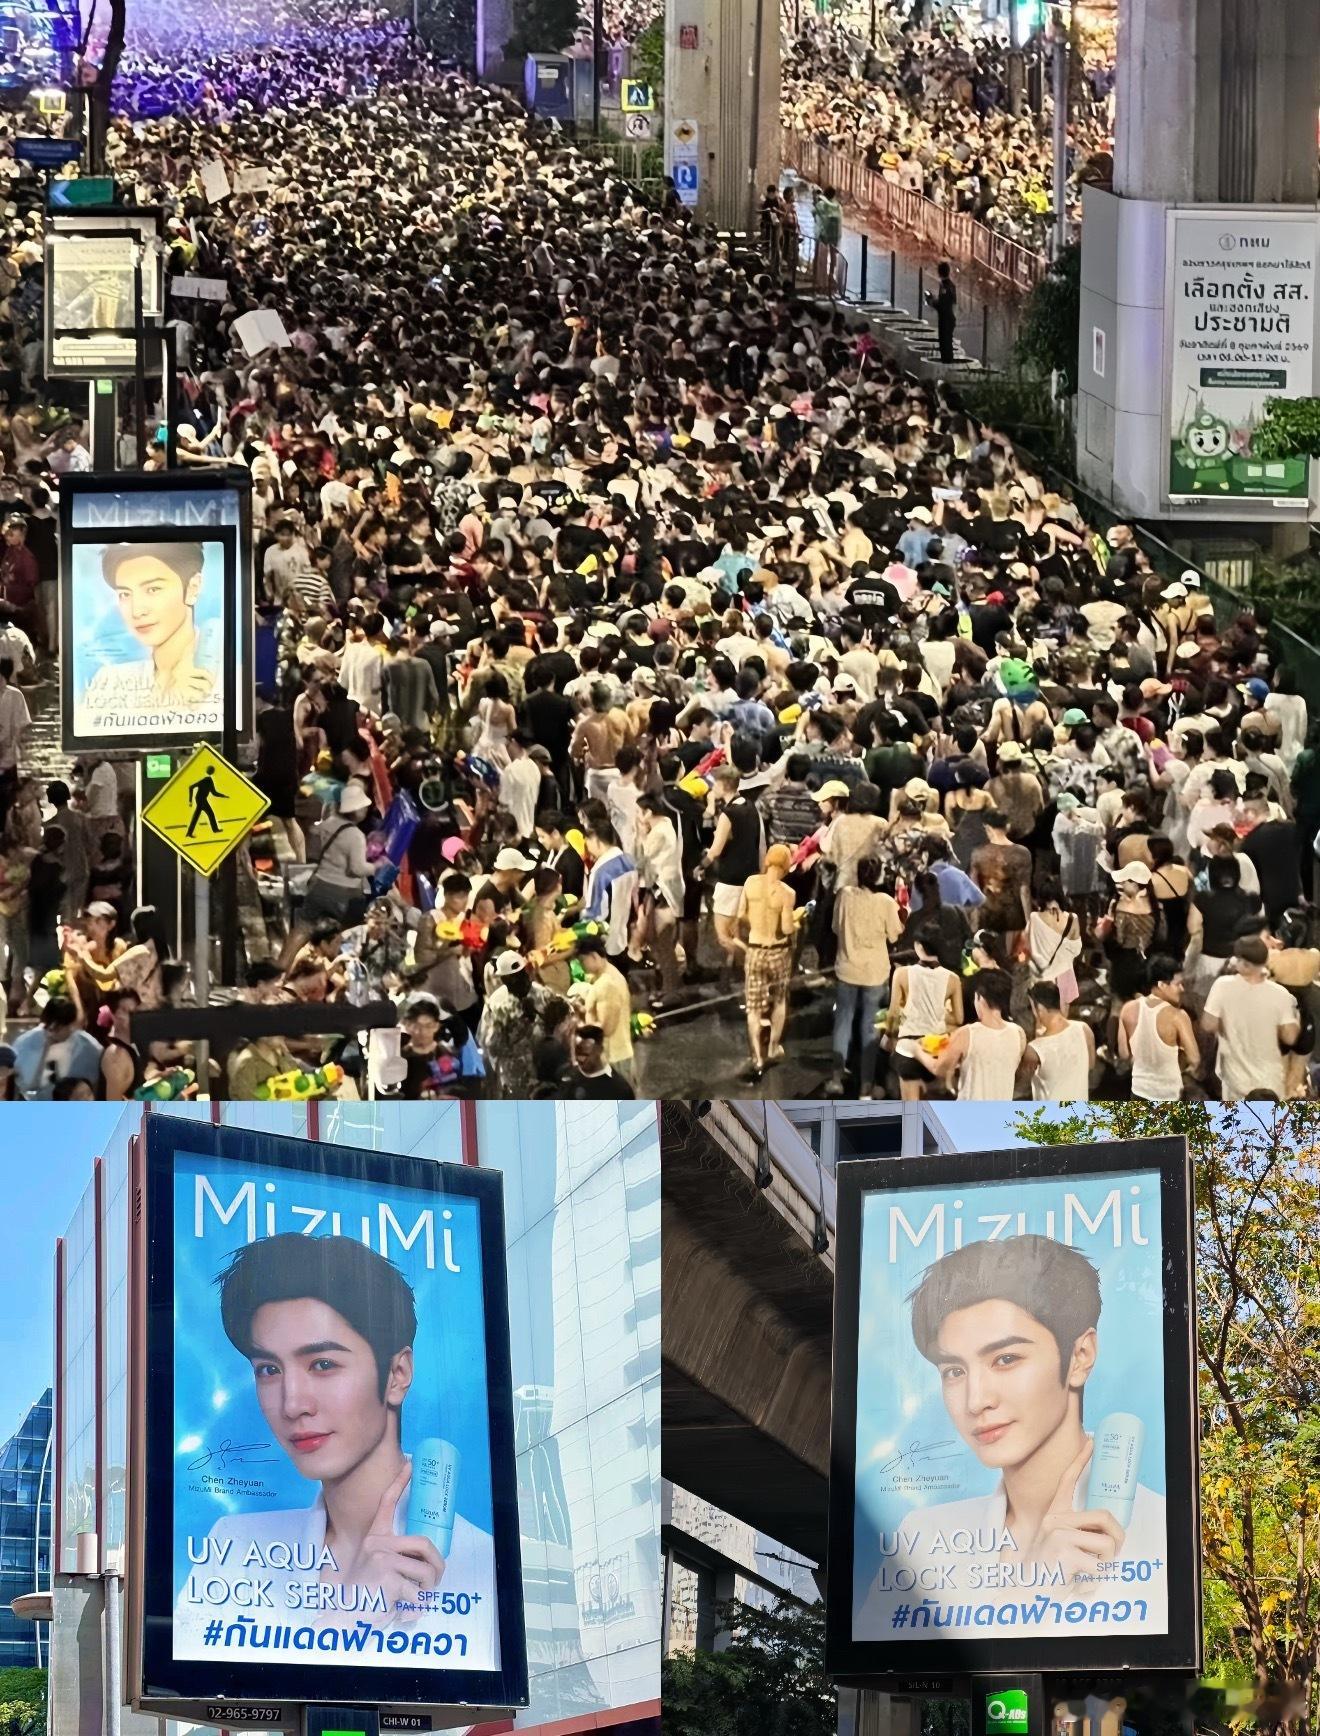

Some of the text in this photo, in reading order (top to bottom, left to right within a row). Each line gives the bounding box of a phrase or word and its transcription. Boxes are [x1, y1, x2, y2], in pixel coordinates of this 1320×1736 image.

[1184, 272, 1309, 300] เลือกตั้ง สส.
[1195, 311, 1290, 333] ประชามติ
[201, 1475, 265, 1488] Chen Zheyuan
[187, 1535, 339, 1573] UV AQUA
[879, 1526, 1018, 1557] UV AQUA
[878, 1559, 1066, 1592] LOCK SERUM
[1096, 1558, 1164, 1582] SPF 50+
[186, 1575, 388, 1613] LOCK SERUM
[417, 1590, 482, 1616] SPF 50+
[891, 1594, 1148, 1629] #กันแดดฟ้าอควา
[203, 1615, 468, 1657] #กันแดดฟ้าอควา
[382, 1717, 421, 1727] CHI-W 01
